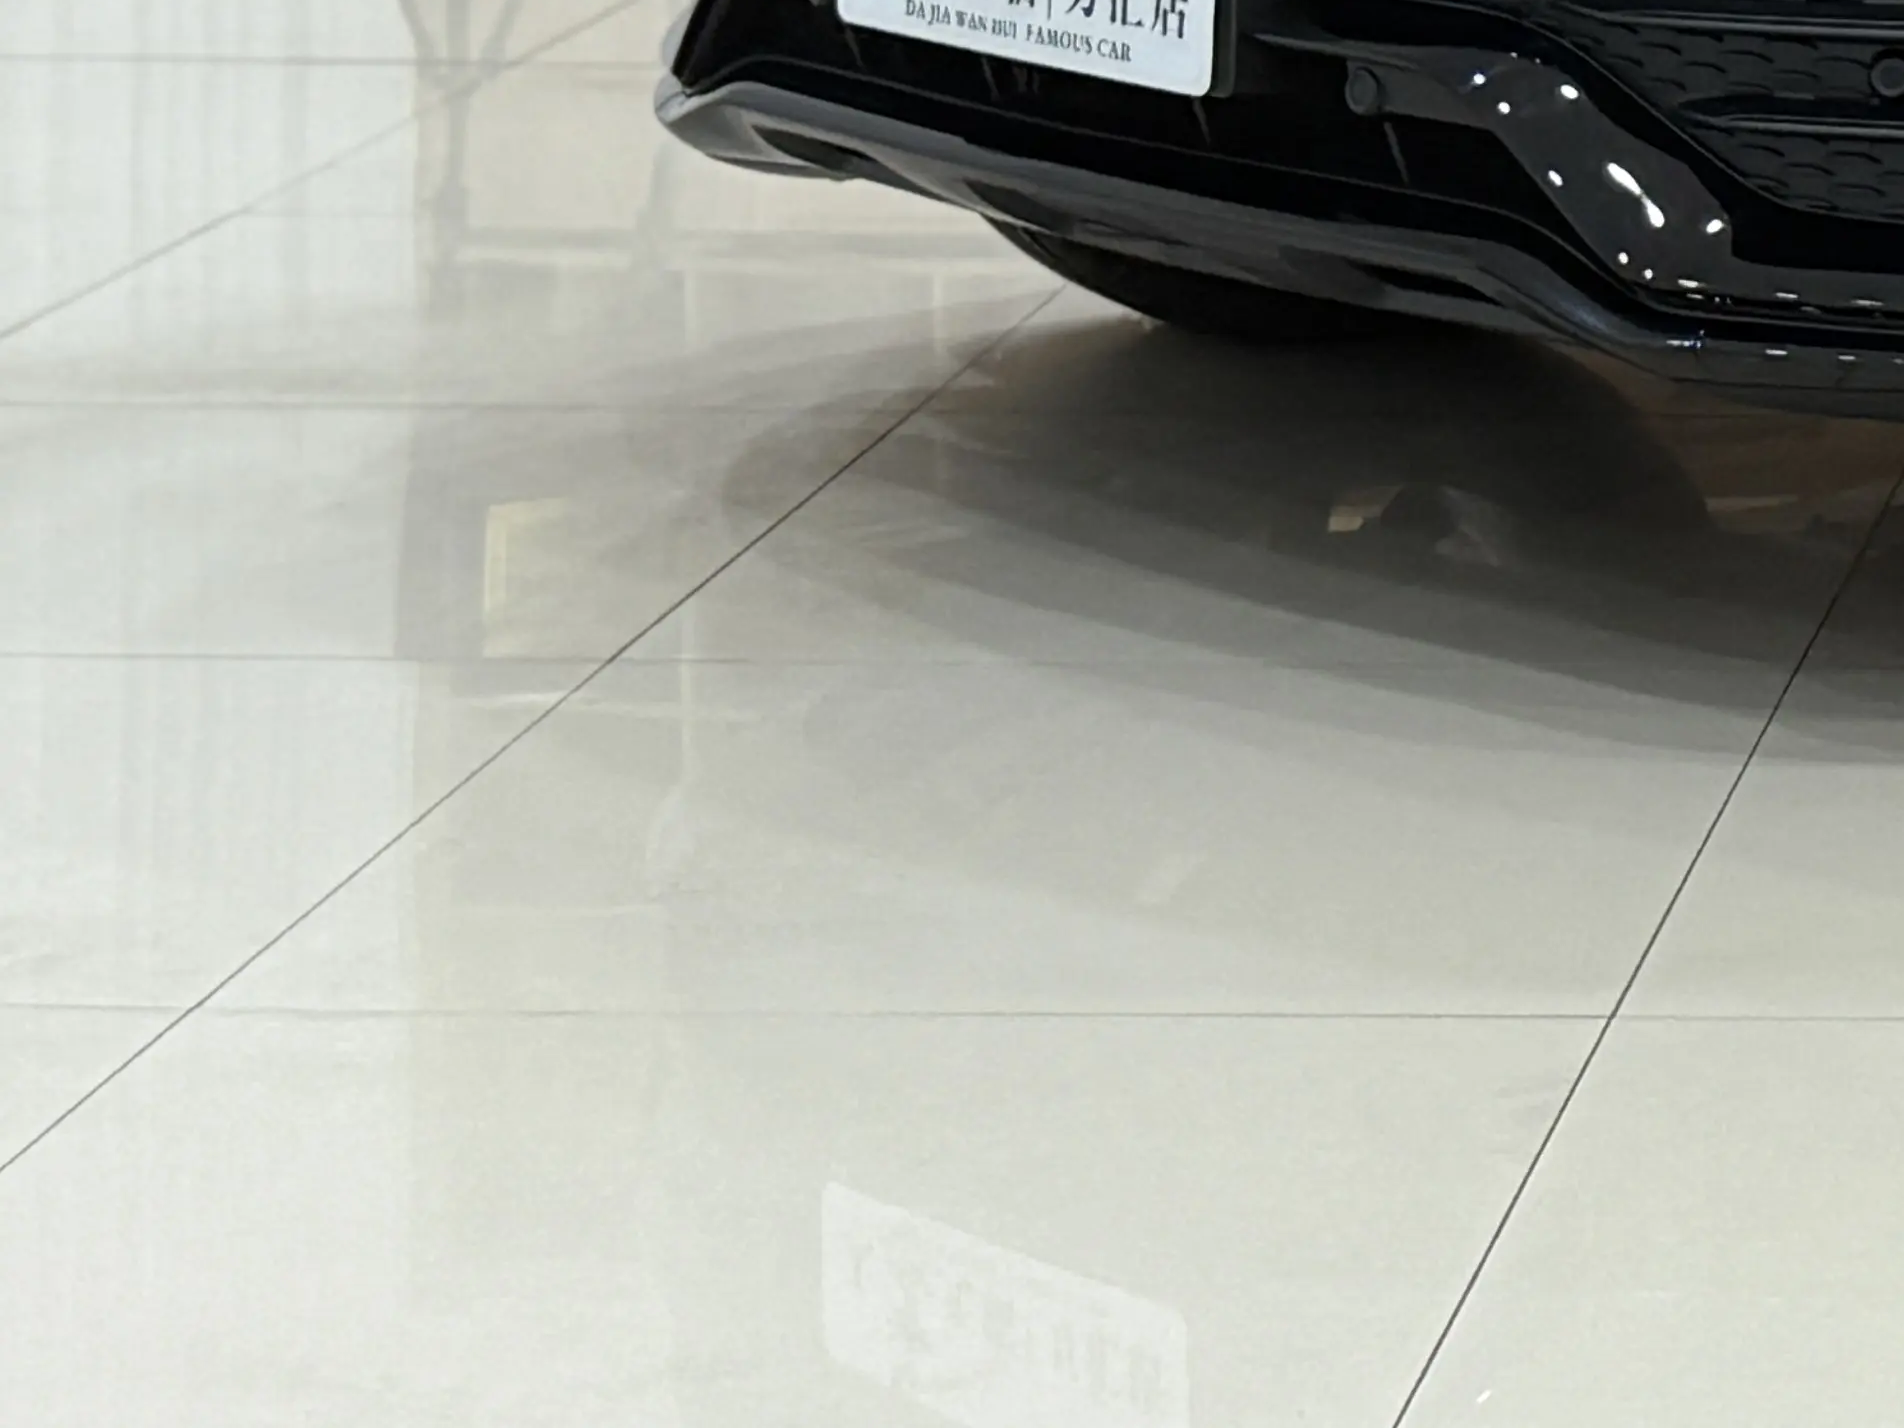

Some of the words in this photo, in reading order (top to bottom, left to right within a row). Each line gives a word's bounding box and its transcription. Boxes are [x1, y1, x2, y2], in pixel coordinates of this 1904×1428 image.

[927, 1, 951, 25] JIA
[955, 9, 987, 33] WAN
[1026, 23, 1092, 55] FAMOUS
[1096, 38, 1132, 62] CAR
